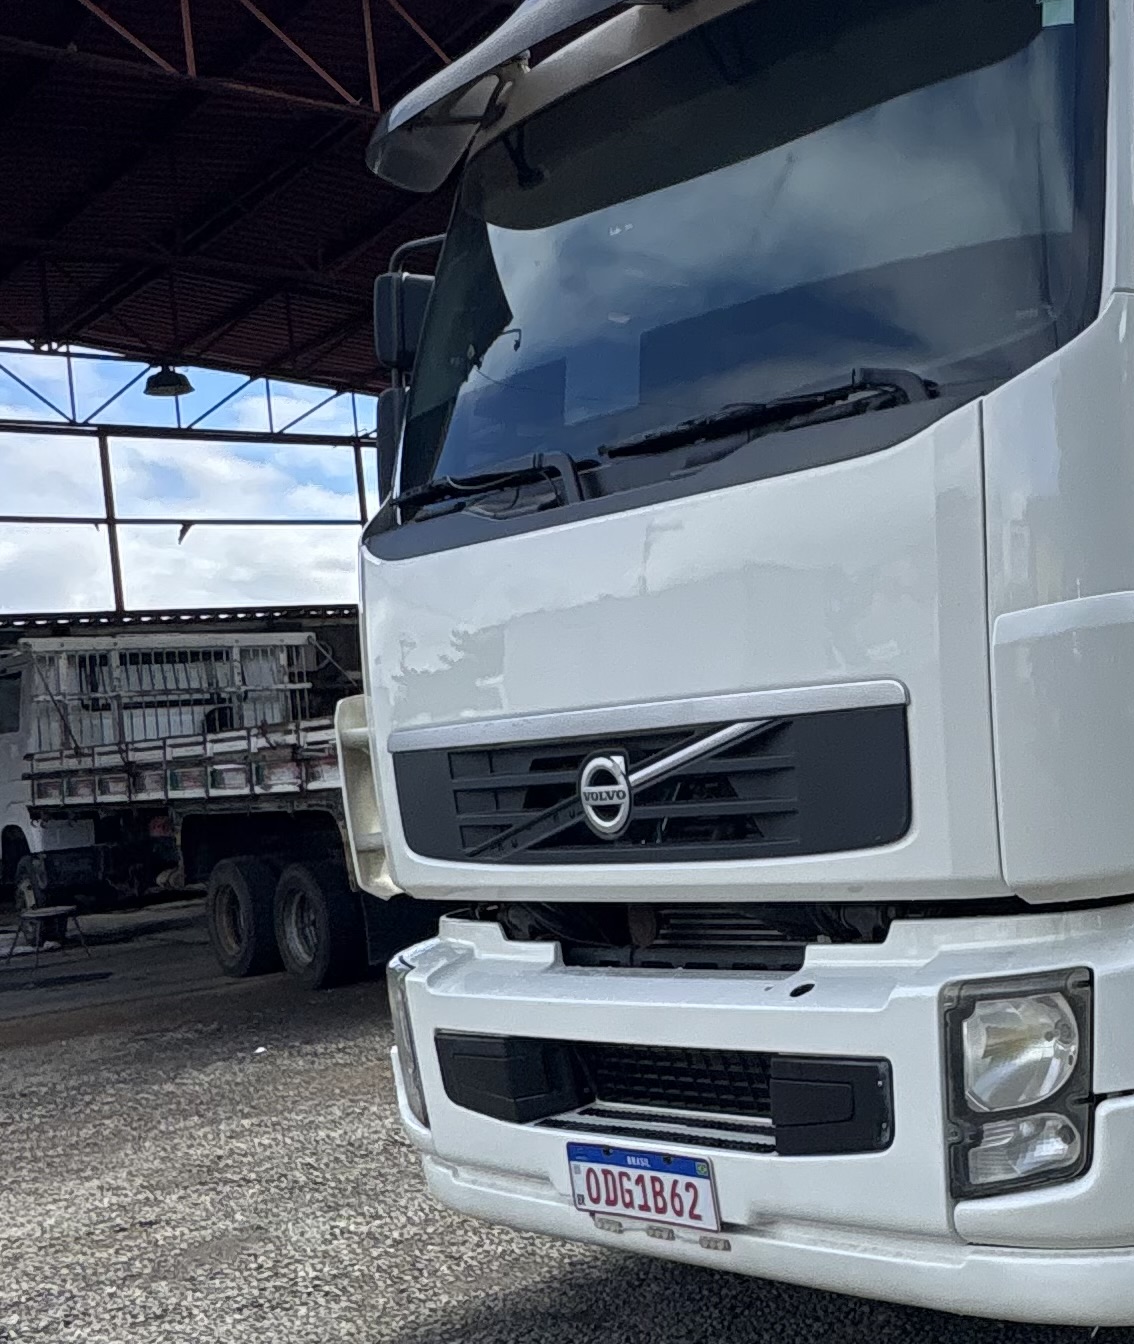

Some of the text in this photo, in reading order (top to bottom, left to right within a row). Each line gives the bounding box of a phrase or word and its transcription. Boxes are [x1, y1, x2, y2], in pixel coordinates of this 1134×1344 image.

[583, 790, 626, 801] VOLVO
[627, 1156, 650, 1166] BRASIL
[586, 1167, 702, 1220] ODG1B62
